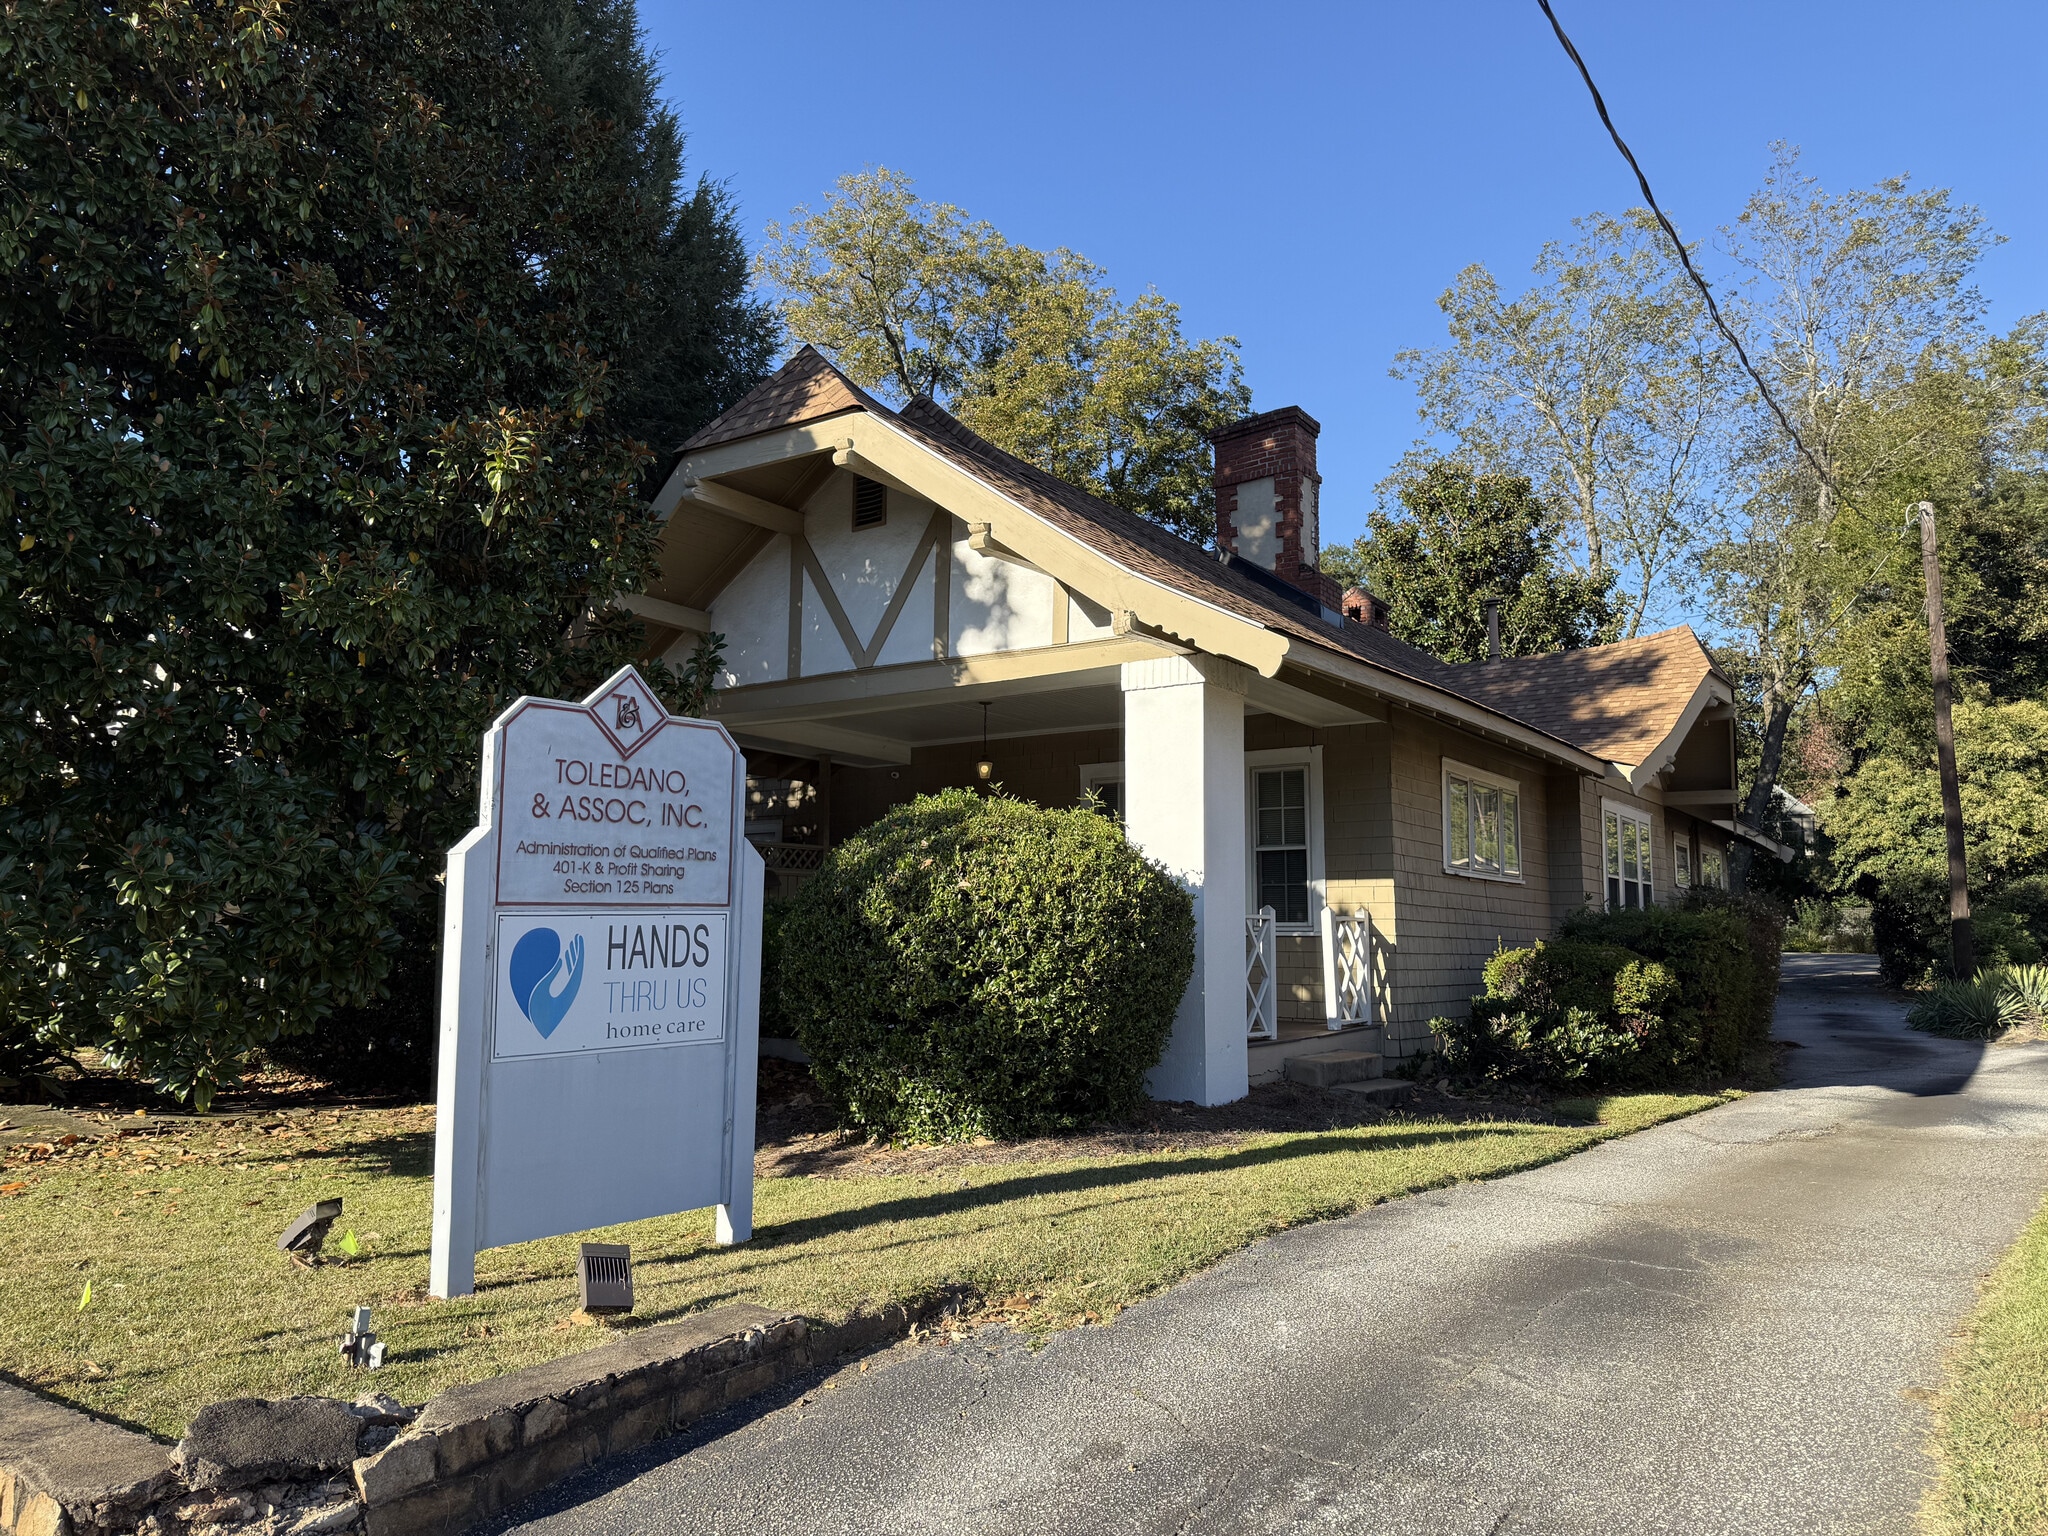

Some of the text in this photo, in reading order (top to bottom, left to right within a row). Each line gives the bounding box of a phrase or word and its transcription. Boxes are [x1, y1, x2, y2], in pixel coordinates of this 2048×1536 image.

[555, 759, 689, 797] TOLEDANO,
[532, 793, 707, 829] & ASSOC, INC.
[516, 840, 717, 861] Administration of Qualified Plans
[553, 861, 685, 879] 401-K & Profit Sharing
[564, 879, 673, 894] Section 125 Plans
[607, 924, 709, 970] HANDS
[603, 977, 707, 1013] THRU US
[606, 1019, 706, 1039] home care
